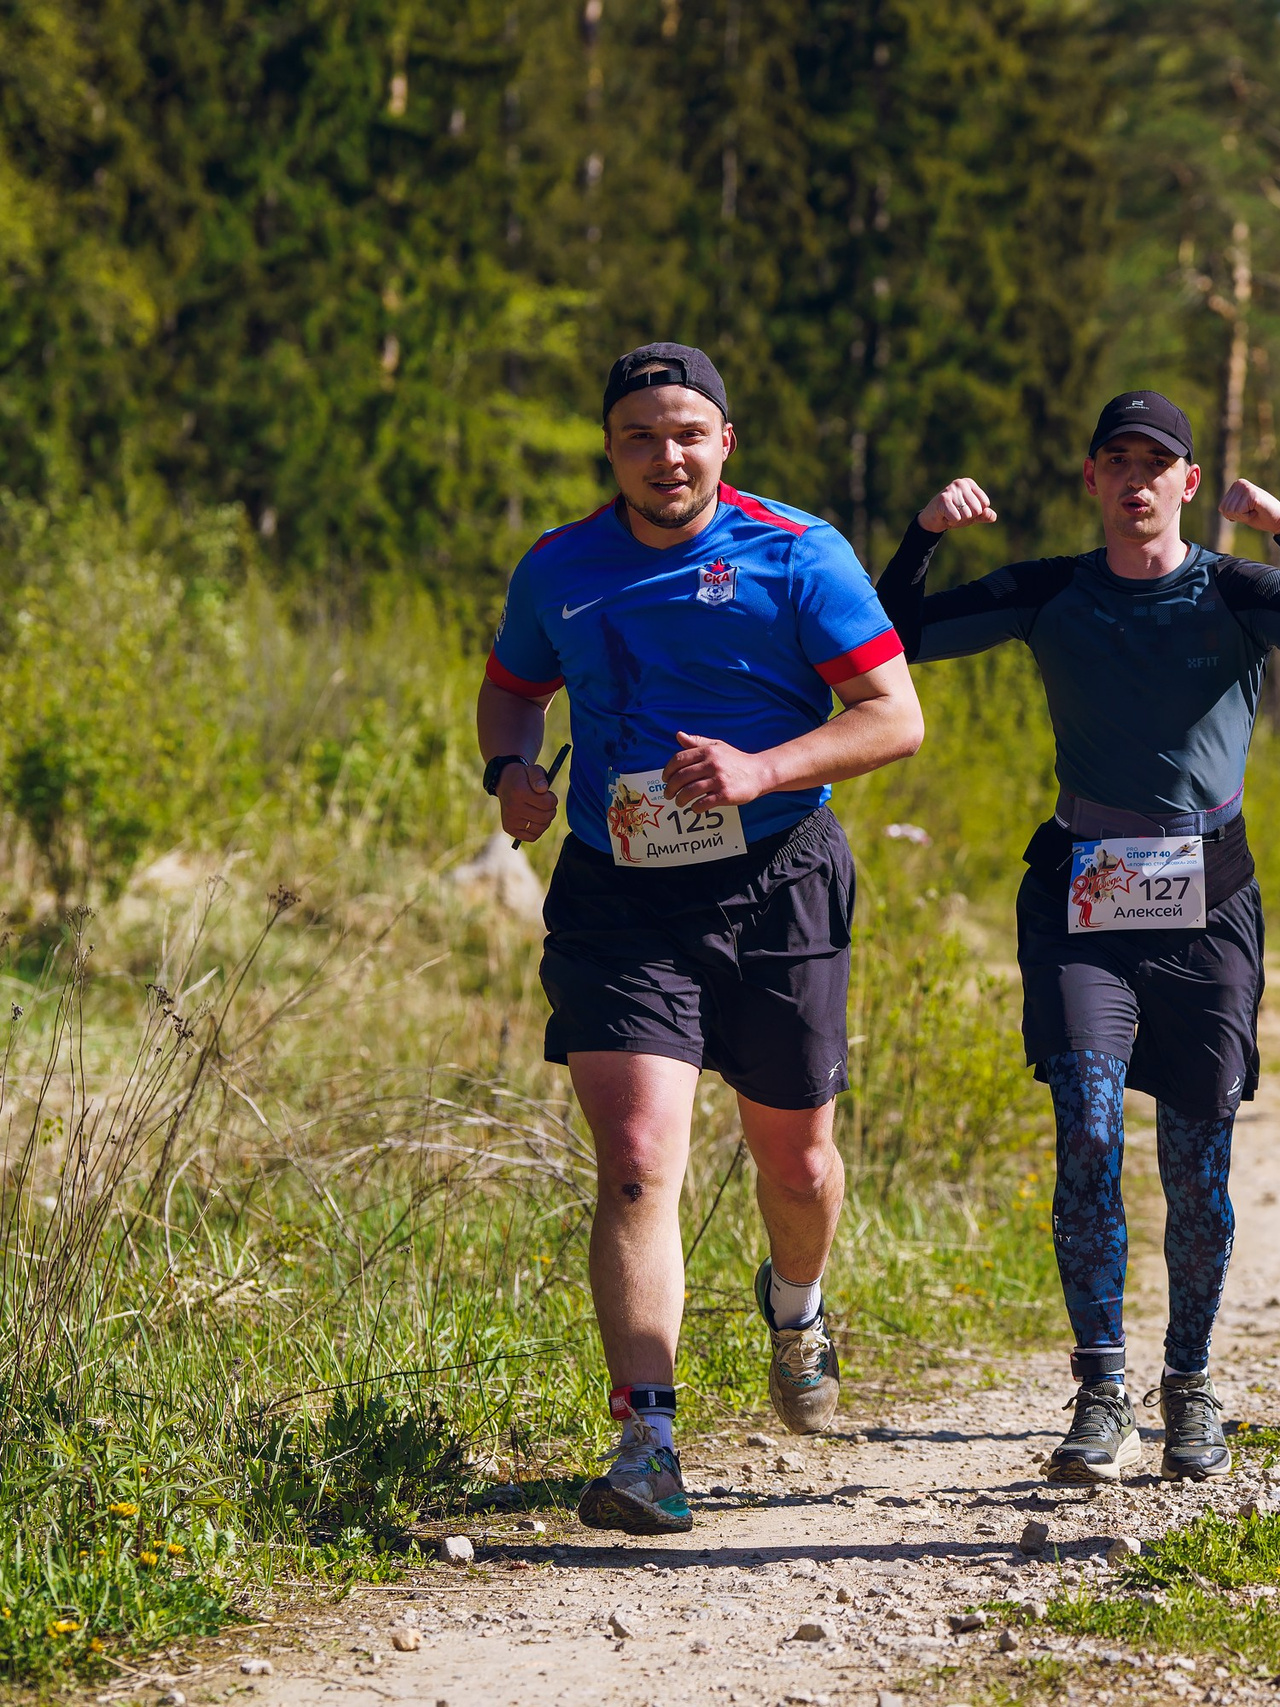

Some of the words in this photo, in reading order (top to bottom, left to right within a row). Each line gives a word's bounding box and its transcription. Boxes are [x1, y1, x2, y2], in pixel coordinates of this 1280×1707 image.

[703, 572, 730, 584] СКА
[666, 807, 724, 835] 125
[646, 832, 724, 858] Дмитрий
[1126, 851, 1157, 859] СПОРТ
[1139, 876, 1191, 901] 127
[1113, 904, 1183, 919] Алексей
